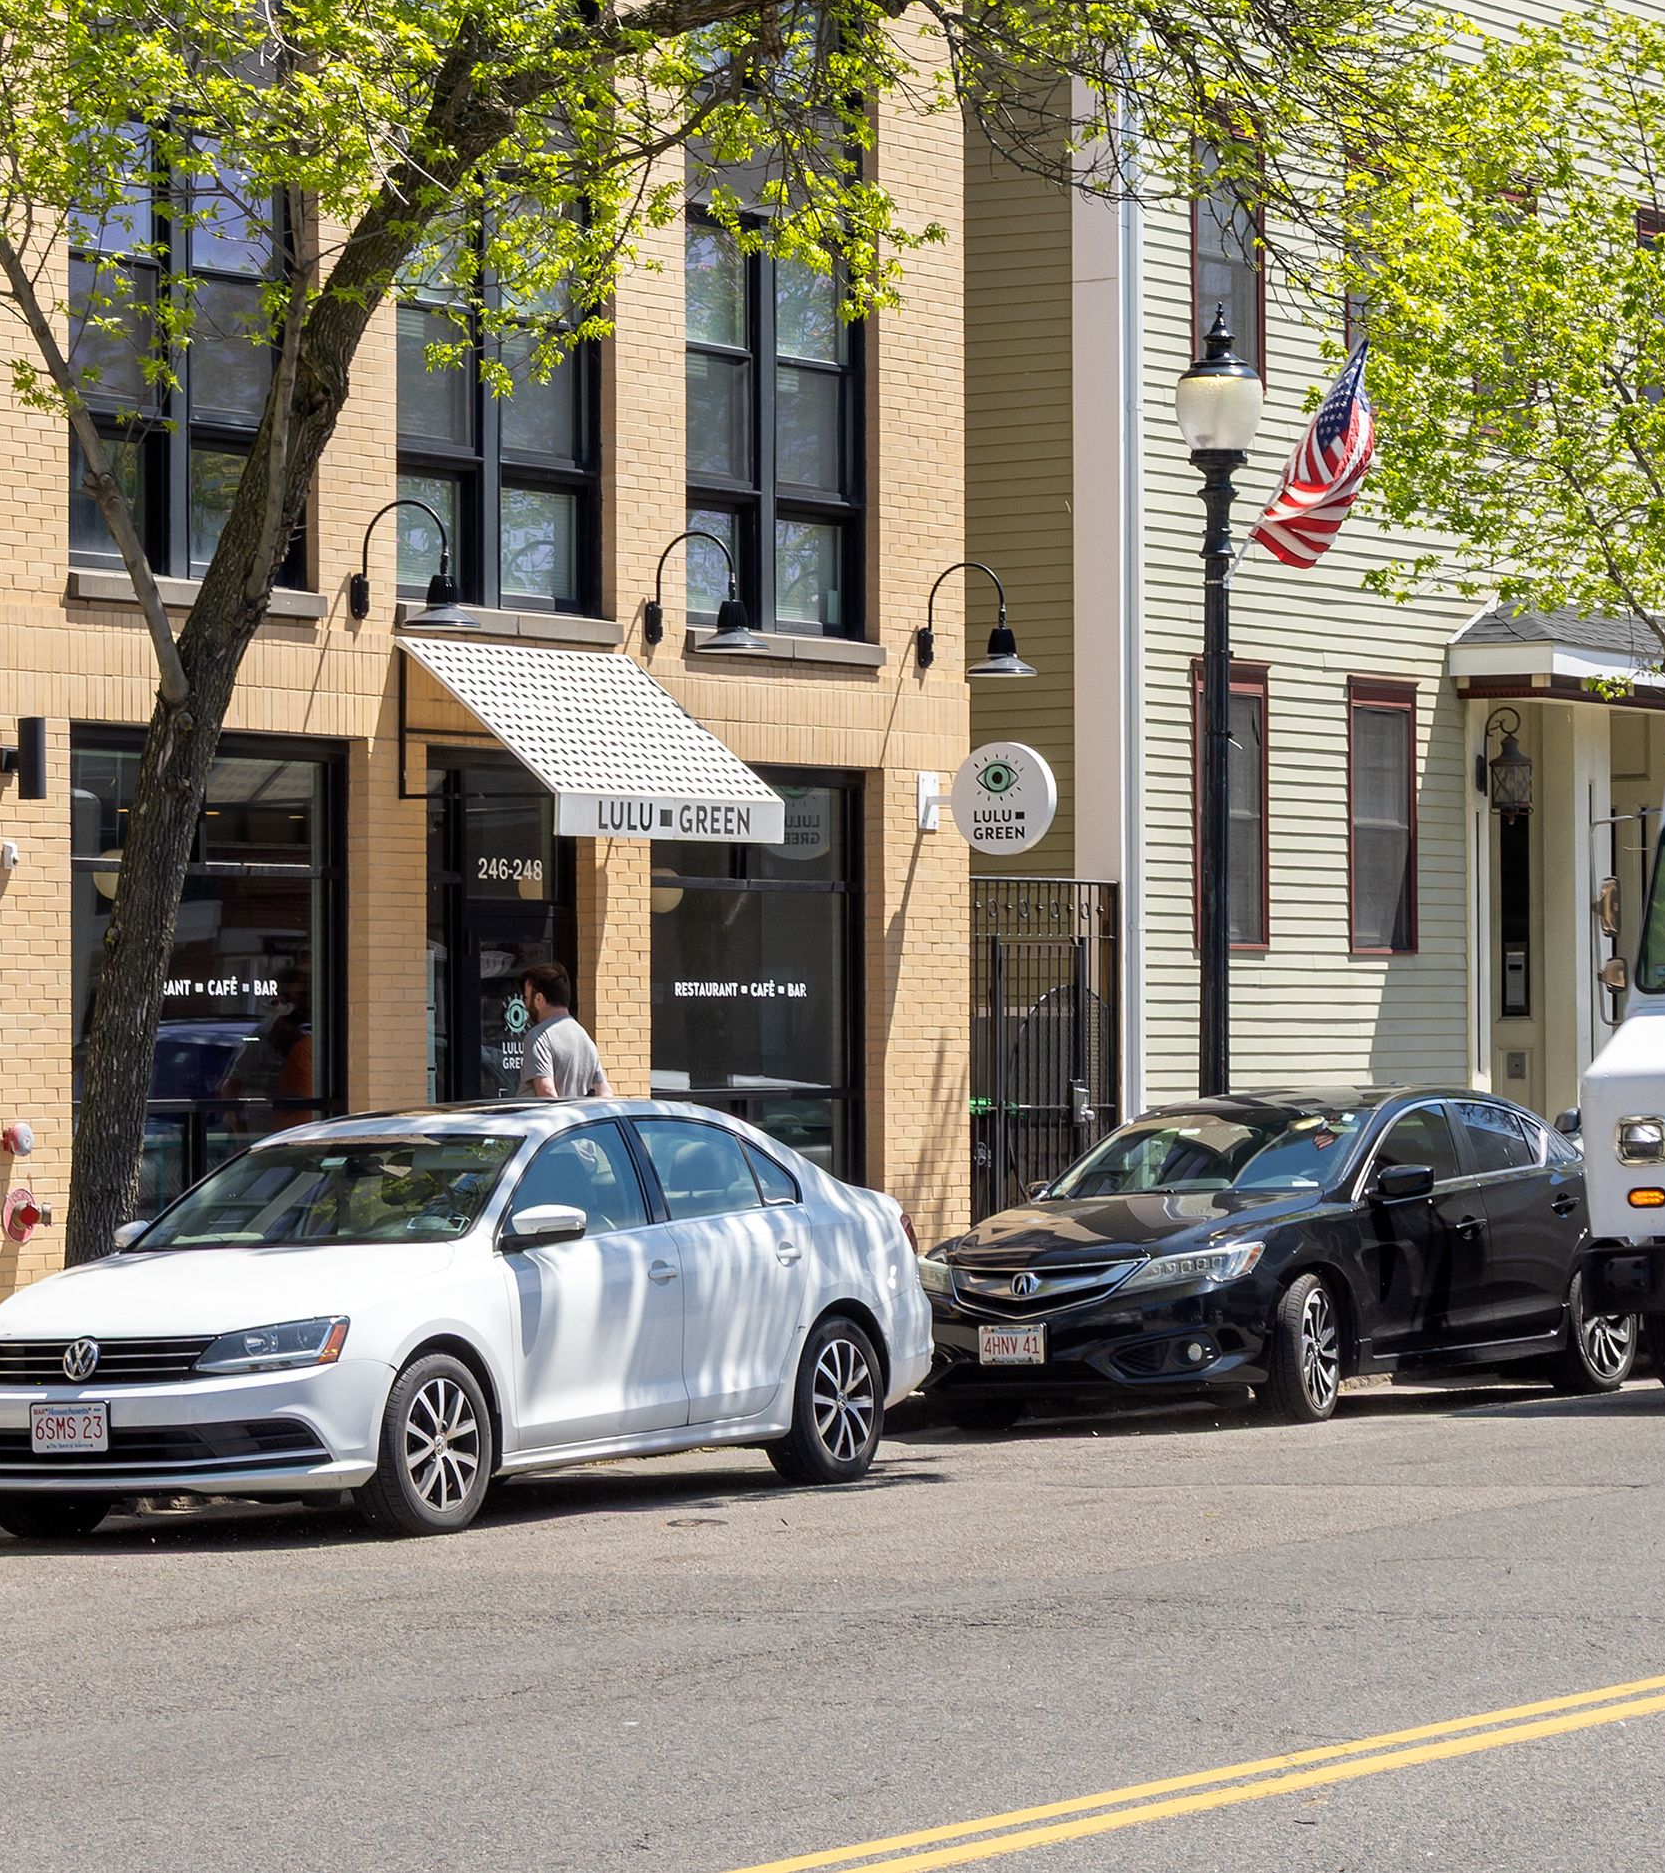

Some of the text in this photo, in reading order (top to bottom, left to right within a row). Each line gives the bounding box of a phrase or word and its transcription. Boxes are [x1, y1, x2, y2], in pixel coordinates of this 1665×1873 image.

[598, 800, 751, 835] LULU GREEN
[974, 809, 1012, 823] LULU
[974, 826, 1025, 840] GREEN
[478, 857, 543, 881] 246-248
[207, 975, 238, 996] CAFÉ
[253, 979, 278, 996] BAR
[675, 979, 807, 997] RESTAURANT CAFÉ BAR
[502, 1041, 524, 1055] LULU
[984, 1336, 1039, 1355] 4HNV 41
[35, 1416, 103, 1440] 6SMS 23
